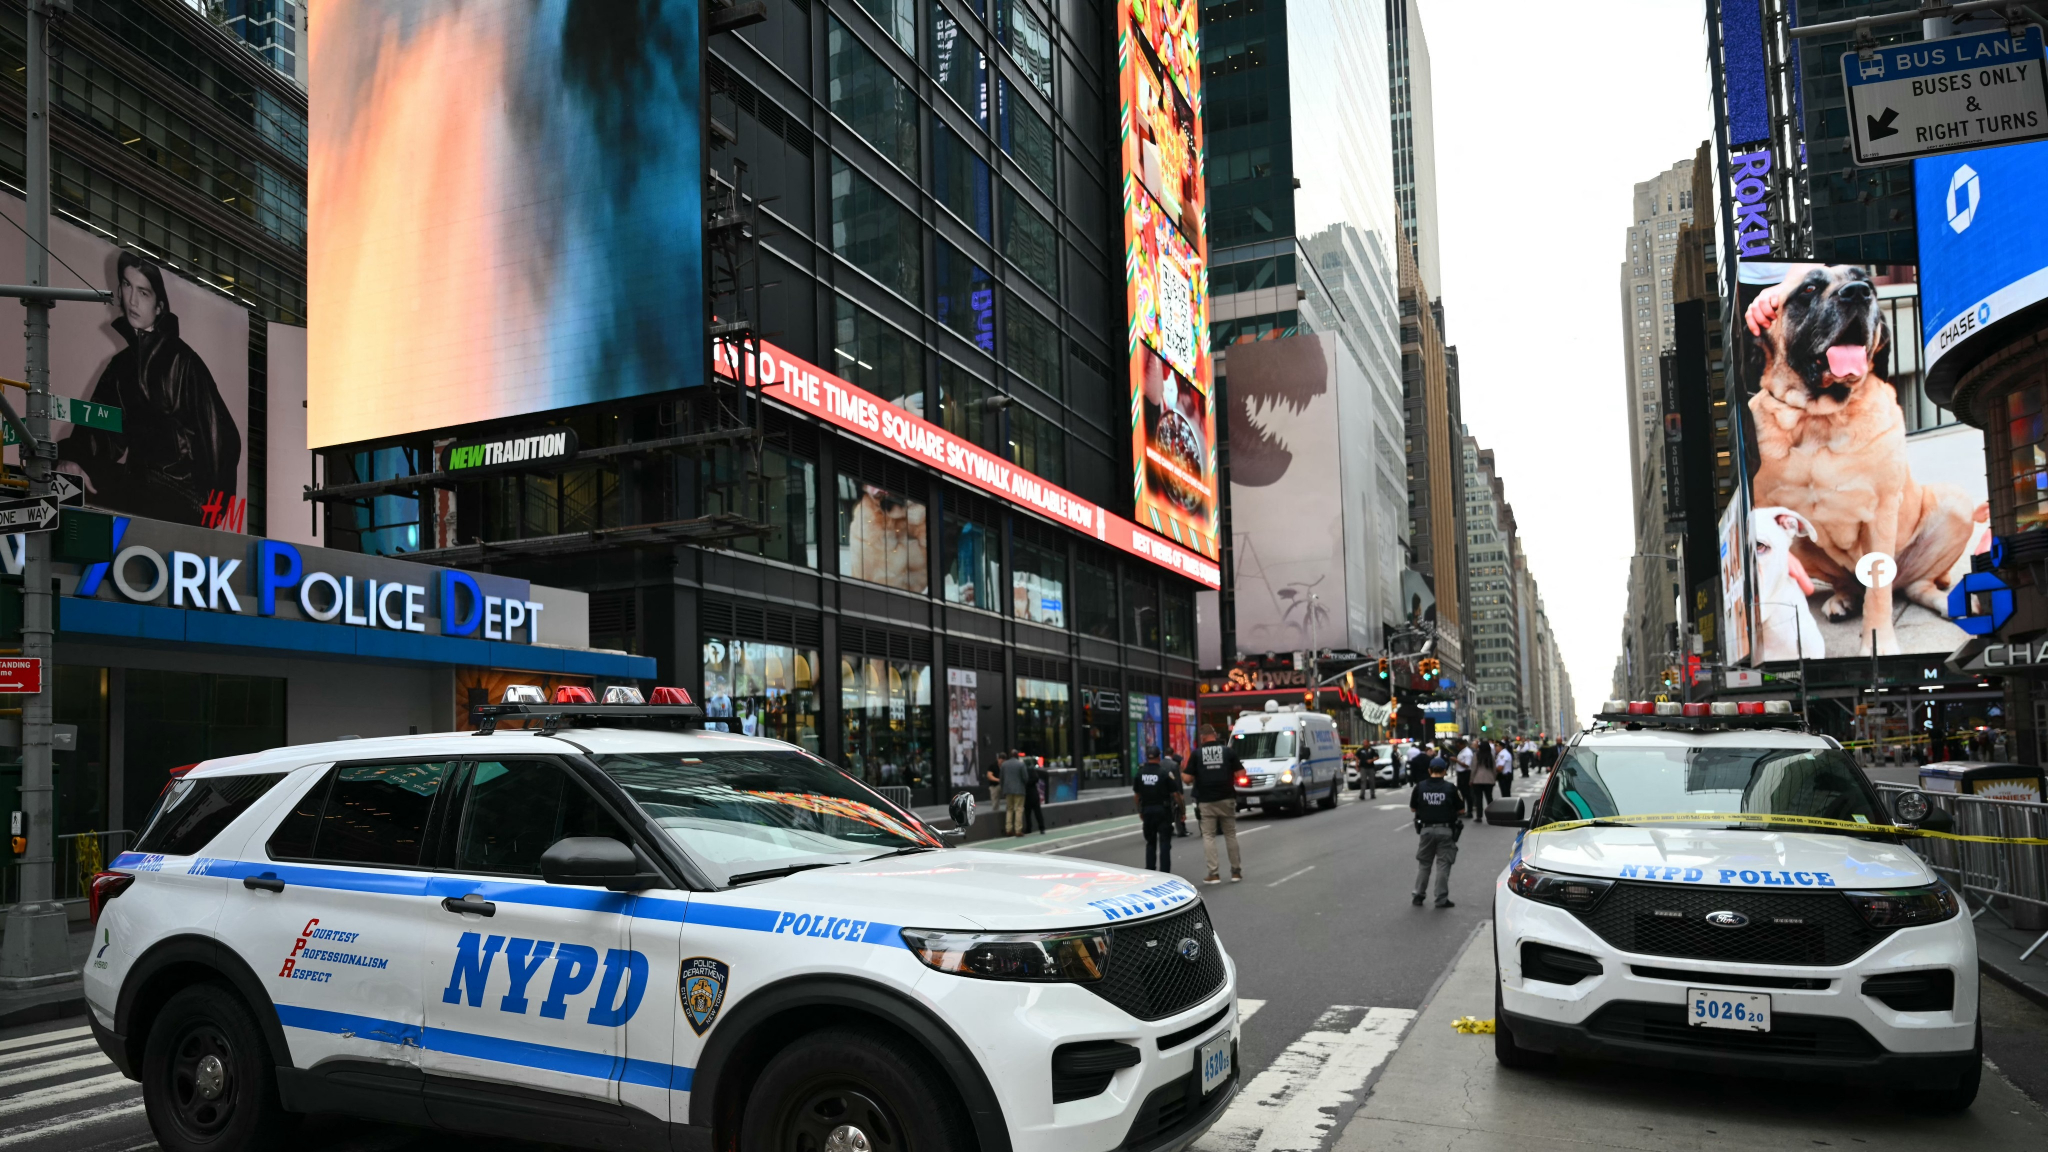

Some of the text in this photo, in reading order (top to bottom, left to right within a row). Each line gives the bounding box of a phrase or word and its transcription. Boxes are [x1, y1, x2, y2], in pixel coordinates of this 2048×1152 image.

[1896, 37, 2027, 71] BUS LANE
[1912, 65, 2027, 97] BUSES ONLY
[1966, 96, 1982, 112] &
[1916, 111, 2038, 143] RIGHT TURNS
[1732, 151, 1771, 258] Roku
[1941, 311, 1975, 349] CHASE
[83, 405, 109, 423] 7 Av
[780, 360, 820, 407] THE
[823, 380, 879, 433] TIMES
[882, 410, 945, 463] SQUARE
[947, 441, 1011, 493] SKYWALK
[1012, 473, 1068, 519] AVAILABLE
[1068, 502, 1093, 529] NOW
[50, 483, 70, 496] AY
[28, 507, 49, 521] WAY
[201, 489, 246, 534] H&M
[1132, 531, 1150, 555] BEST
[258, 539, 425, 632] POLICE
[440, 569, 544, 643] DEPT
[1202, 746, 1223, 755] NYPD
[1203, 754, 1223, 762] POLICE
[1142, 774, 1158, 782] NYPD
[1423, 792, 1446, 801] NYPD
[1620, 864, 1836, 887] NYPD POLICE
[1087, 893, 1156, 921] NYPD
[1716, 914, 1740, 924] Ford
[302, 919, 359, 943] COURTESY
[775, 912, 868, 942] POLICE
[290, 938, 389, 970] PROFESSIONALISM
[694, 960, 717, 970] POLICE
[279, 958, 332, 984] RESPECT
[442, 932, 649, 1027] NYPD
[683, 968, 725, 984] DEPARTMENT
[681, 987, 694, 1018] CITY OF
[706, 989, 724, 1025] NEW YORK
